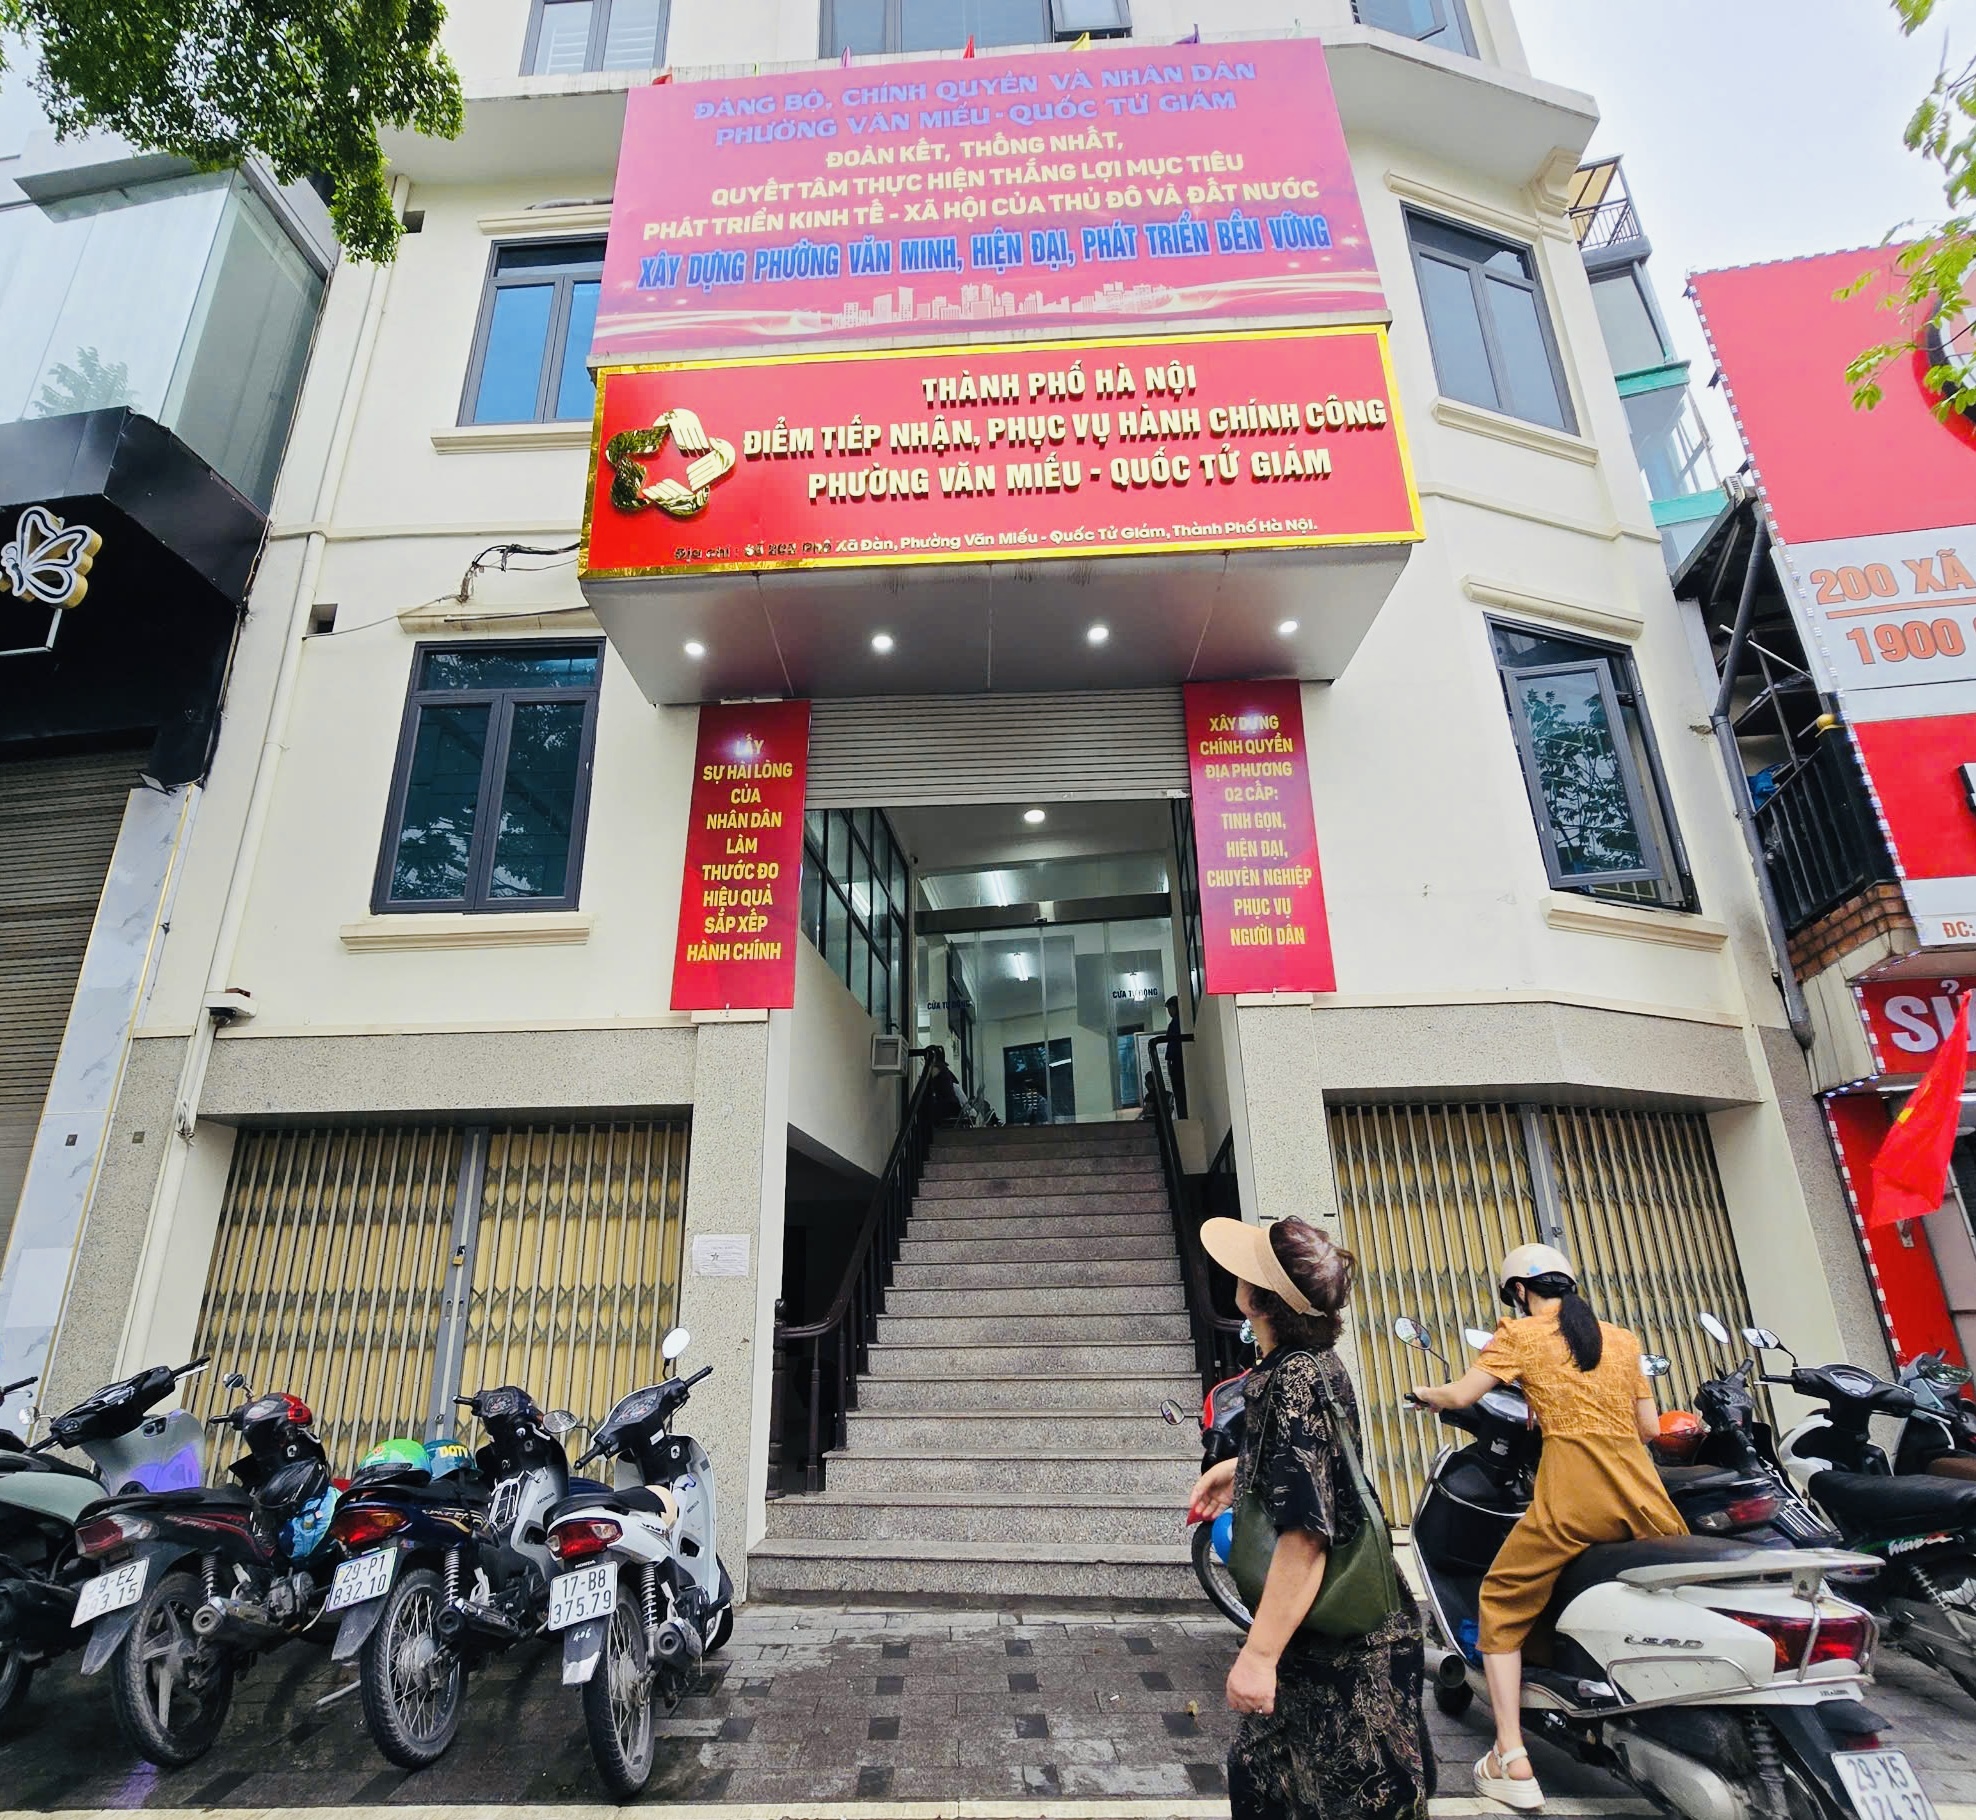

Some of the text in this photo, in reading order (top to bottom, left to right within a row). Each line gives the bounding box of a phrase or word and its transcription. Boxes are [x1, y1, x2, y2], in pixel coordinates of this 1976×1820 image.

[842, 81, 927, 106] CHÍNH
[1049, 67, 1093, 91] VÀ
[1101, 64, 1183, 89] NHÂN
[1191, 60, 1256, 83] DÂN
[715, 118, 837, 147] PHƯỜNG
[847, 111, 910, 135] VĂN
[1159, 88, 1236, 113] GIÁM
[826, 125, 1124, 168] ĐOÀN KẾT, THỐNG NHẤT,
[797, 176, 849, 201] TÂM
[853, 173, 923, 198] THỰC
[928, 166, 985, 194] HIỆN
[989, 158, 1077, 187] THẮNG
[1082, 159, 1122, 186] LỢI
[1127, 156, 1183, 184] MỤC
[1187, 150, 1244, 174] TIÊU
[643, 215, 708, 242] PHÁT
[712, 206, 788, 235] TRIỂN
[790, 208, 849, 231] KINH
[903, 197, 941, 223] XÃ
[944, 195, 986, 222] HỘI
[991, 191, 1046, 217] CỦA
[1048, 186, 1102, 212] THỦ
[1105, 185, 1143, 209] ĐÔ
[1242, 175, 1320, 201] NƯỚC
[637, 208, 1333, 293] XÂY DỰNG PHƯỜNG VĂN MINH, HIỆN ĐẠI, PHÁT TRIỂN BỀN VỮNG
[921, 359, 1197, 404] THÀNH PHỐ HÀ NỘI
[743, 393, 1388, 456] ĐIỂM TIẾP NHẬN, PHỤC VỤ HÀNH CHÍNH CÔNG
[808, 460, 929, 500] PHƯỜNG
[937, 460, 996, 493] VĂN
[1006, 452, 1082, 491] MIẾU
[1110, 446, 1191, 488] QUỐC
[1250, 442, 1333, 478] GIÁM
[860, 535, 898, 552] Đàn,
[900, 532, 961, 551] Phường
[964, 532, 995, 547] Văn
[998, 527, 1038, 545] Miếu
[1050, 525, 1096, 545] Quốc
[1121, 521, 1171, 540] Giám,
[1172, 519, 1223, 537] Thành
[1225, 516, 1257, 534] Phố
[1259, 516, 1283, 533] Hà
[1285, 517, 1318, 536] Nội.
[1809, 547, 1976, 605] 200 XÃ
[1846, 617, 1967, 666] 1900
[1209, 713, 1236, 732] XÂY
[1200, 732, 1294, 756] CHÍNH QUYỀN
[703, 761, 793, 785] SỰ HÀI LÒNG
[1205, 761, 1293, 782] ĐỊA PHƯƠNG
[731, 783, 762, 805] CỦA
[1224, 787, 1243, 801] 02
[706, 808, 782, 830] NHÂN DÂN
[1221, 811, 1287, 832] TINH GỌN,
[726, 834, 758, 855] LÀM
[1226, 838, 1289, 861] HIỆN ĐẠI,
[702, 860, 779, 881] THƯỚC ĐO
[1206, 864, 1313, 889] CHUYÊN NGHIỆP
[703, 884, 773, 910] HIỆU QUẢ
[1233, 898, 1292, 920] PHỤC VỤ
[704, 908, 768, 934] SẮP XẾP
[1230, 923, 1306, 946] NGƯỜI DÂN
[1942, 920, 1976, 939] ĐC:
[687, 938, 782, 962] HÀNH CHÍNH
[90, 1565, 137, 1594] 9-E2
[342, 1554, 386, 1584] 29-P1
[333, 1573, 387, 1607] 832.10
[562, 1568, 606, 1599] 17-B8
[553, 1589, 612, 1625] 375.79
[1846, 1755, 1909, 1791] 29-X5
